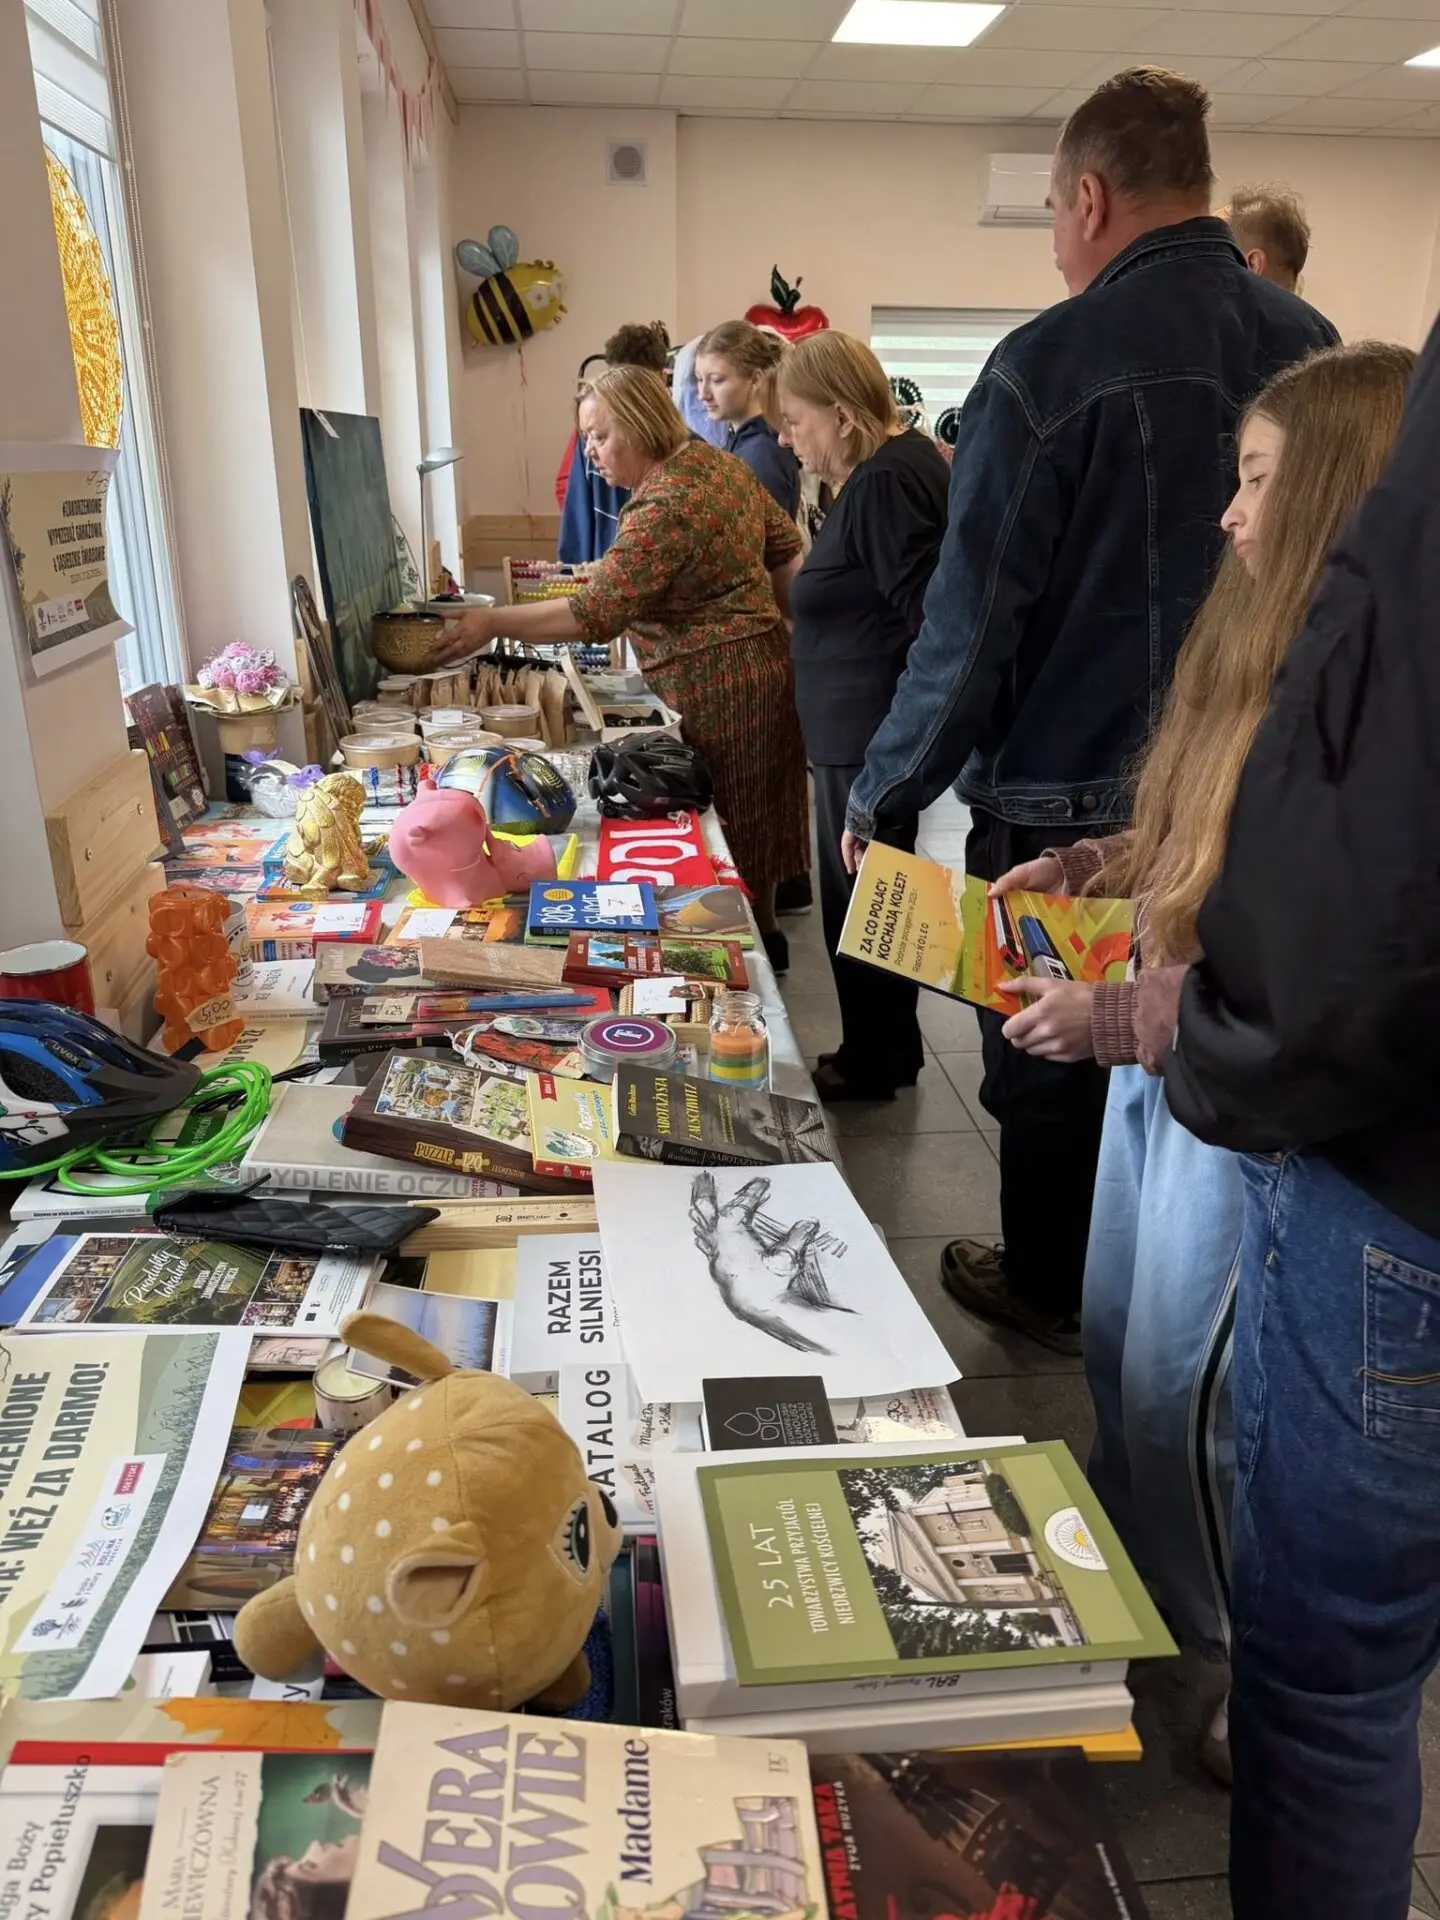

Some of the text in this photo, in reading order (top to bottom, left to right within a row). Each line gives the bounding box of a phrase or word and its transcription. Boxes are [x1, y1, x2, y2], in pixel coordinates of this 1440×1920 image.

[860, 878, 888, 955] ZA CO POLACY
[876, 871, 908, 960] KOCHAJĄ KOLEJ?
[653, 1077, 671, 1136] SABOTAŻYSTA
[684, 1082, 701, 1135] AUSCHWITZ
[247, 1166, 391, 1192] MYDLENIE
[397, 1174, 472, 1197] OCZU
[415, 1143, 454, 1164] PUZZLE
[463, 1153, 483, 1170] 120
[124, 1250, 180, 1305] Produkty
[154, 1259, 190, 1297] lokalne
[547, 1260, 571, 1334] RAZEM
[578, 1249, 605, 1344] SILNIEJSI
[42, 1362, 110, 1461] DARMO!
[584, 1369, 616, 1498] ATALOG
[781, 1402, 796, 1445] EUROPEJSKI
[790, 1402, 805, 1445] FUNDUSZ
[798, 1402, 813, 1445] ROZWOJU
[26, 1467, 75, 1498] ZA
[749, 1522, 794, 1609] 25 LAT
[793, 1556, 830, 1634] TOWARZYSTWA
[804, 1502, 857, 1625] NIEDRZWICY KOŚCIELNEJ
[926, 1673, 961, 1689] BAL
[29, 1754, 92, 1894] Popiełuszko
[504, 1731, 590, 1920] OWIE
[617, 1737, 652, 1886] Madame
[833, 1781, 852, 1830] MUZYKA
[7, 1820, 45, 1872] Boży
[814, 1783, 859, 1920] ATNIA TAKA
